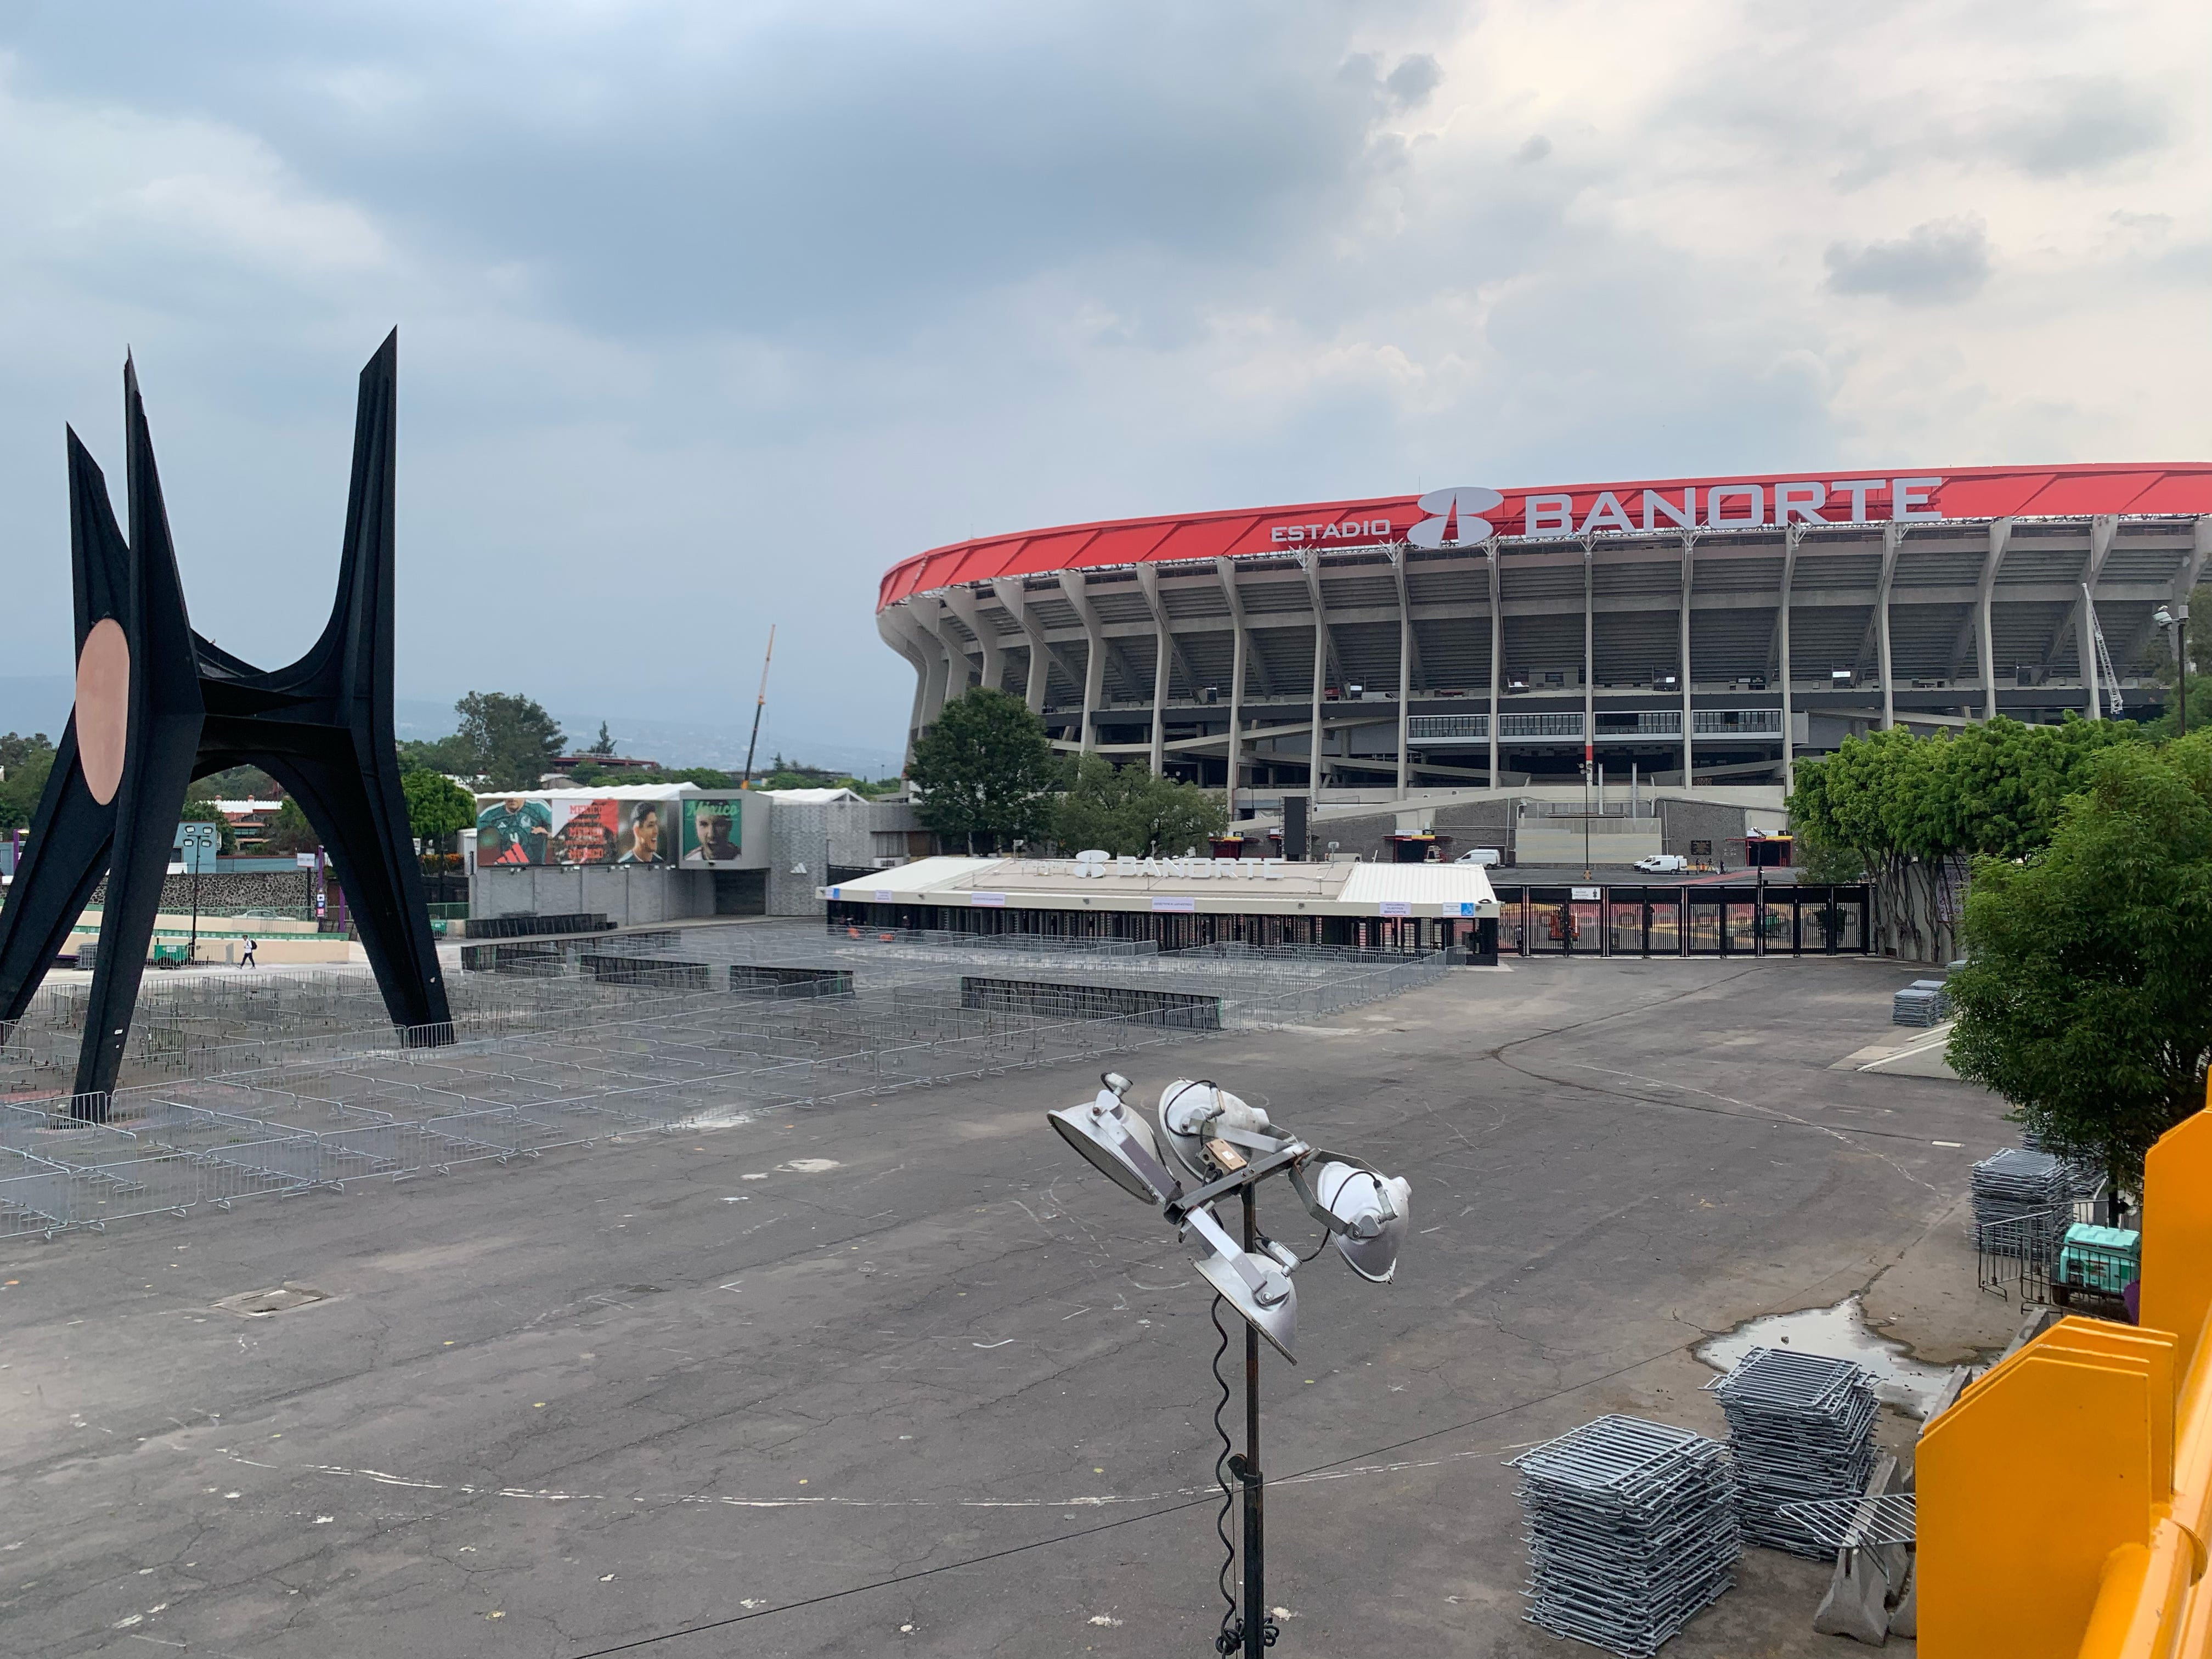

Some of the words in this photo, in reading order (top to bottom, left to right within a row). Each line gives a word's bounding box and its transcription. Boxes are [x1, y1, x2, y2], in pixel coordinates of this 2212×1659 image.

[1272, 519, 1390, 543] ESTADIO
[1525, 477, 1943, 538] BANORTE
[1116, 856, 1284, 878] BANORTE
